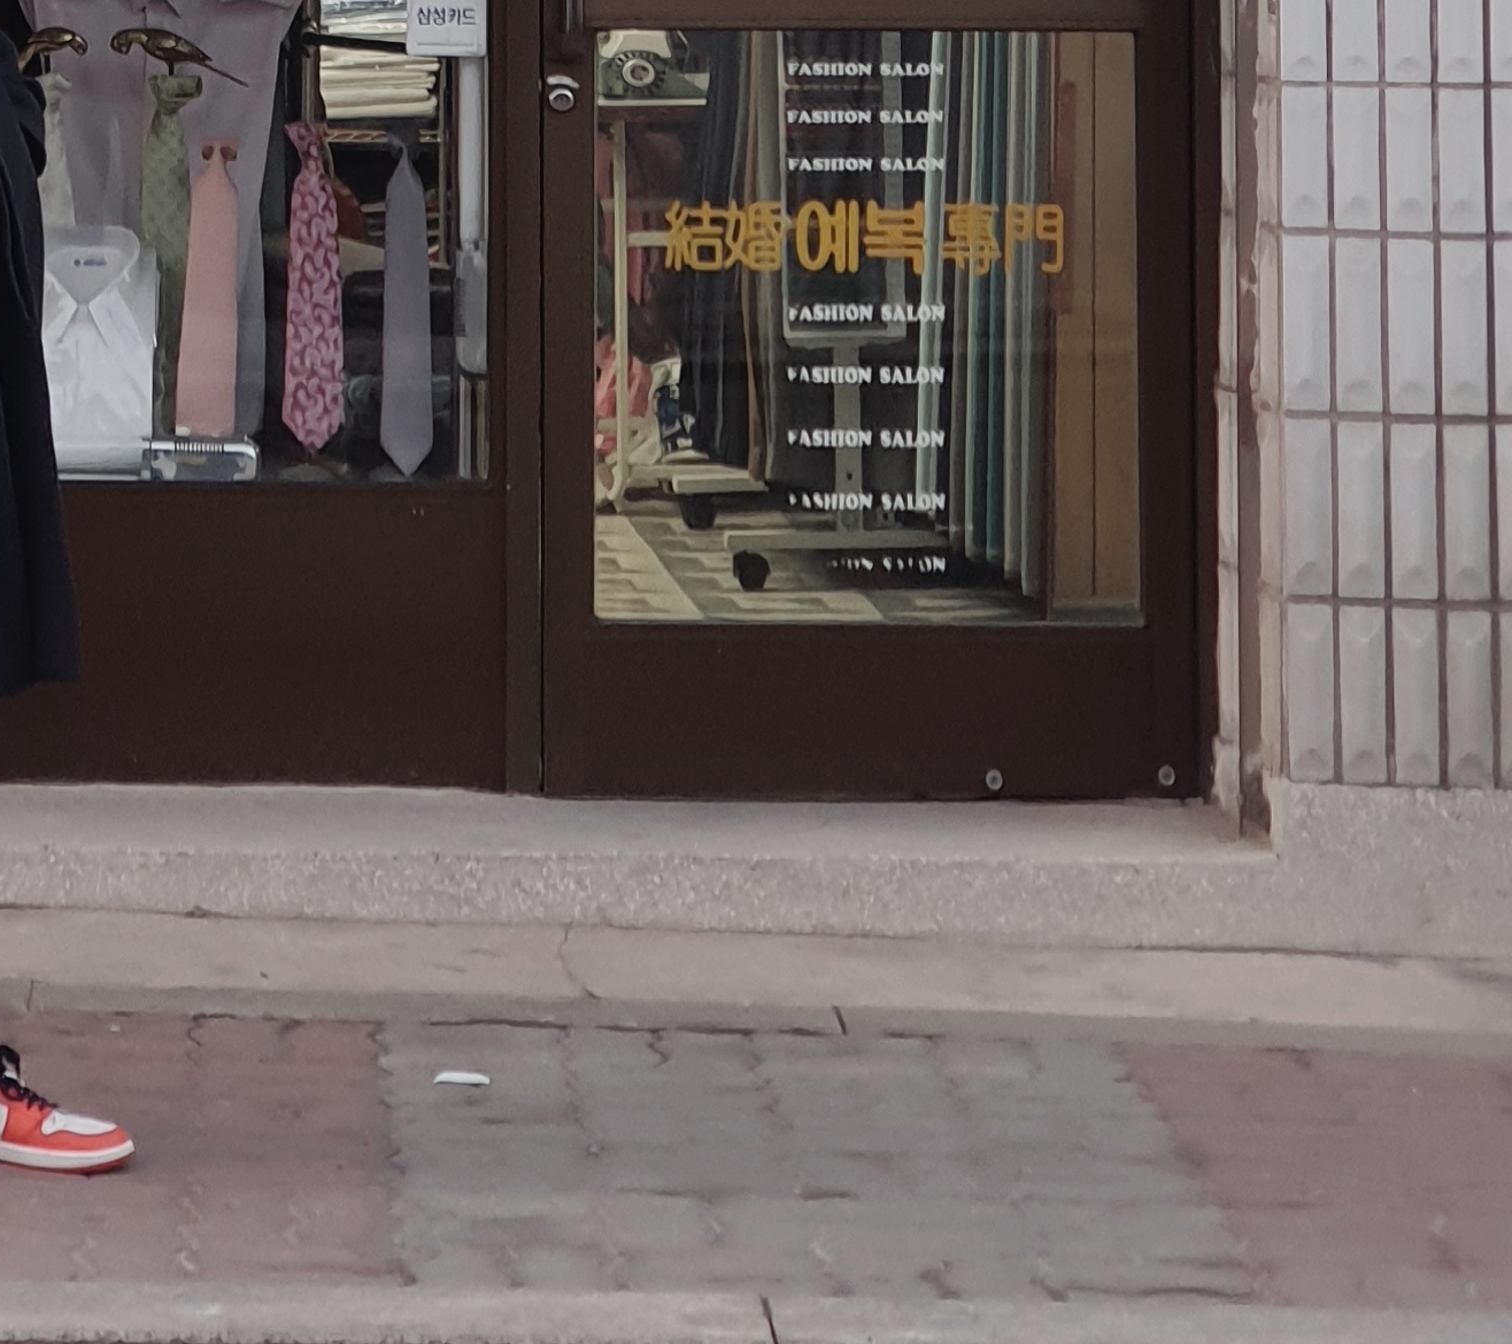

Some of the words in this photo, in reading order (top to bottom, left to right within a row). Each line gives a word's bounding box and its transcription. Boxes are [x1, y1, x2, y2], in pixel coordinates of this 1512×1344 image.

[416, 5, 478, 27] 삼성카드
[787, 62, 873, 77] FASHION
[879, 62, 945, 77] SALON
[787, 109, 872, 124] FASHION
[879, 109, 944, 124] SALON
[787, 157, 873, 172] FASHION
[880, 157, 945, 172] SALON
[788, 303, 874, 322] FASHION
[880, 303, 946, 322] SALON
[879, 365, 945, 385] SALON
[880, 428, 946, 449] SALON
[881, 492, 946, 511] SALON
